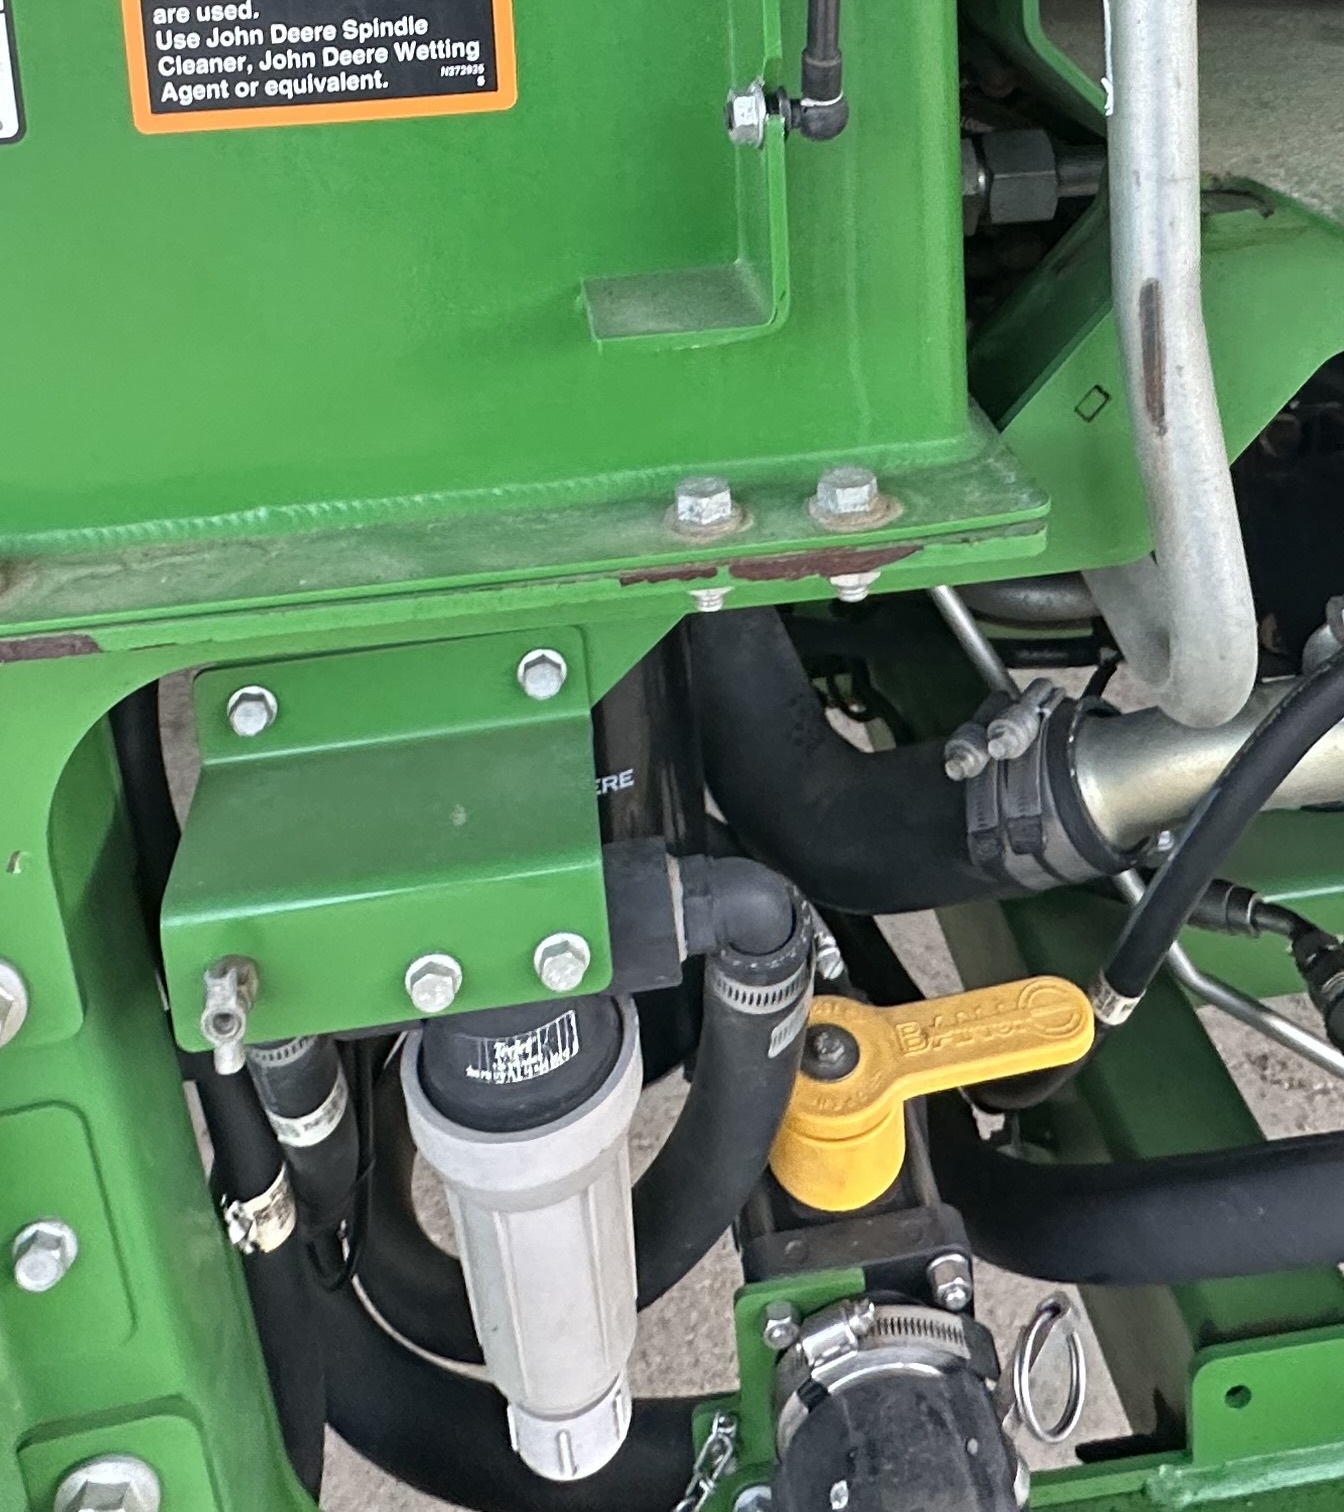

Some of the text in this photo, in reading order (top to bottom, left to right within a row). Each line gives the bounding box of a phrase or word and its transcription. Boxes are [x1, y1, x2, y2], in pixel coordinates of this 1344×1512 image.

[153, 0, 259, 24] are used.
[156, 15, 428, 50] Use John Deere Spindle
[158, 38, 480, 76] Cleaner, John Deere Wetting
[161, 70, 388, 106] Agent or equivalent.
